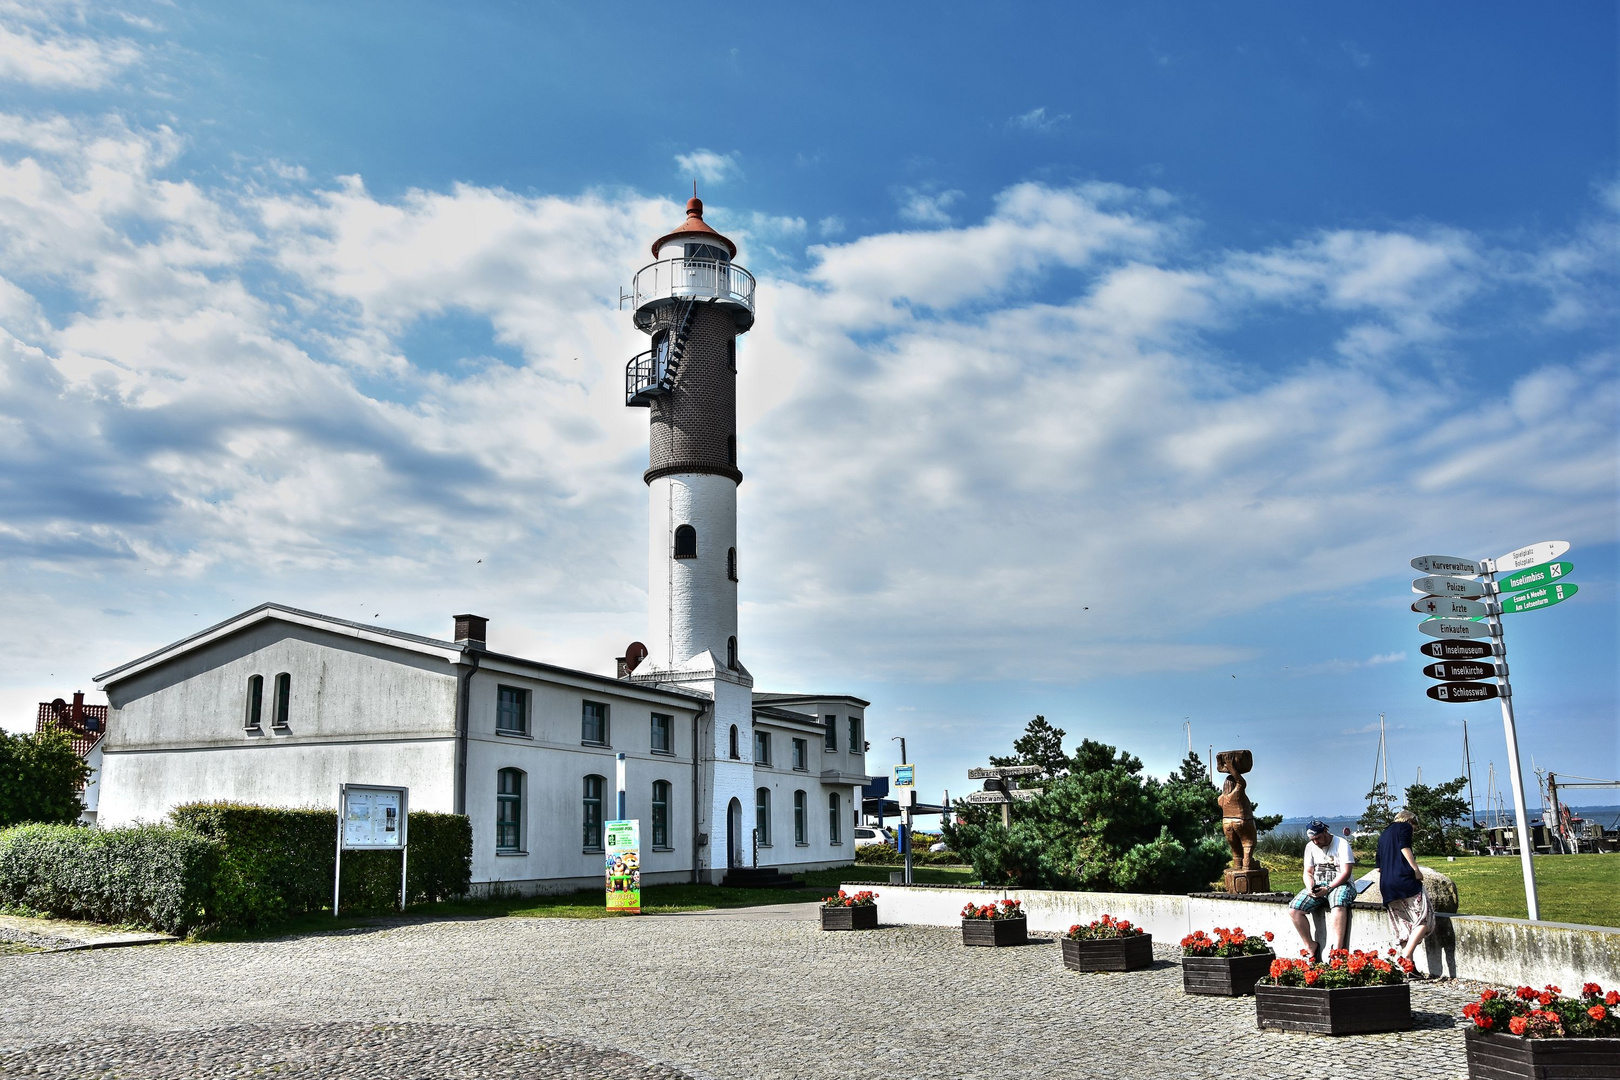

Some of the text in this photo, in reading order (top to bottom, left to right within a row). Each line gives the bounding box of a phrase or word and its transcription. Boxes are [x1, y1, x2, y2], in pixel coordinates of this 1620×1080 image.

[1512, 549, 1534, 560] Spielplatz
[1432, 560, 1475, 574] Kurverwaltung
[1510, 571, 1545, 588] Inselimbiss
[1446, 582, 1466, 592] Polizei
[1452, 602, 1468, 613] Ärzte
[1440, 624, 1470, 634] Einkaufen
[1445, 645, 1484, 655] Inselmuseum
[1451, 666, 1484, 676] Inselkirche
[1452, 687, 1488, 697] Schlosswall
